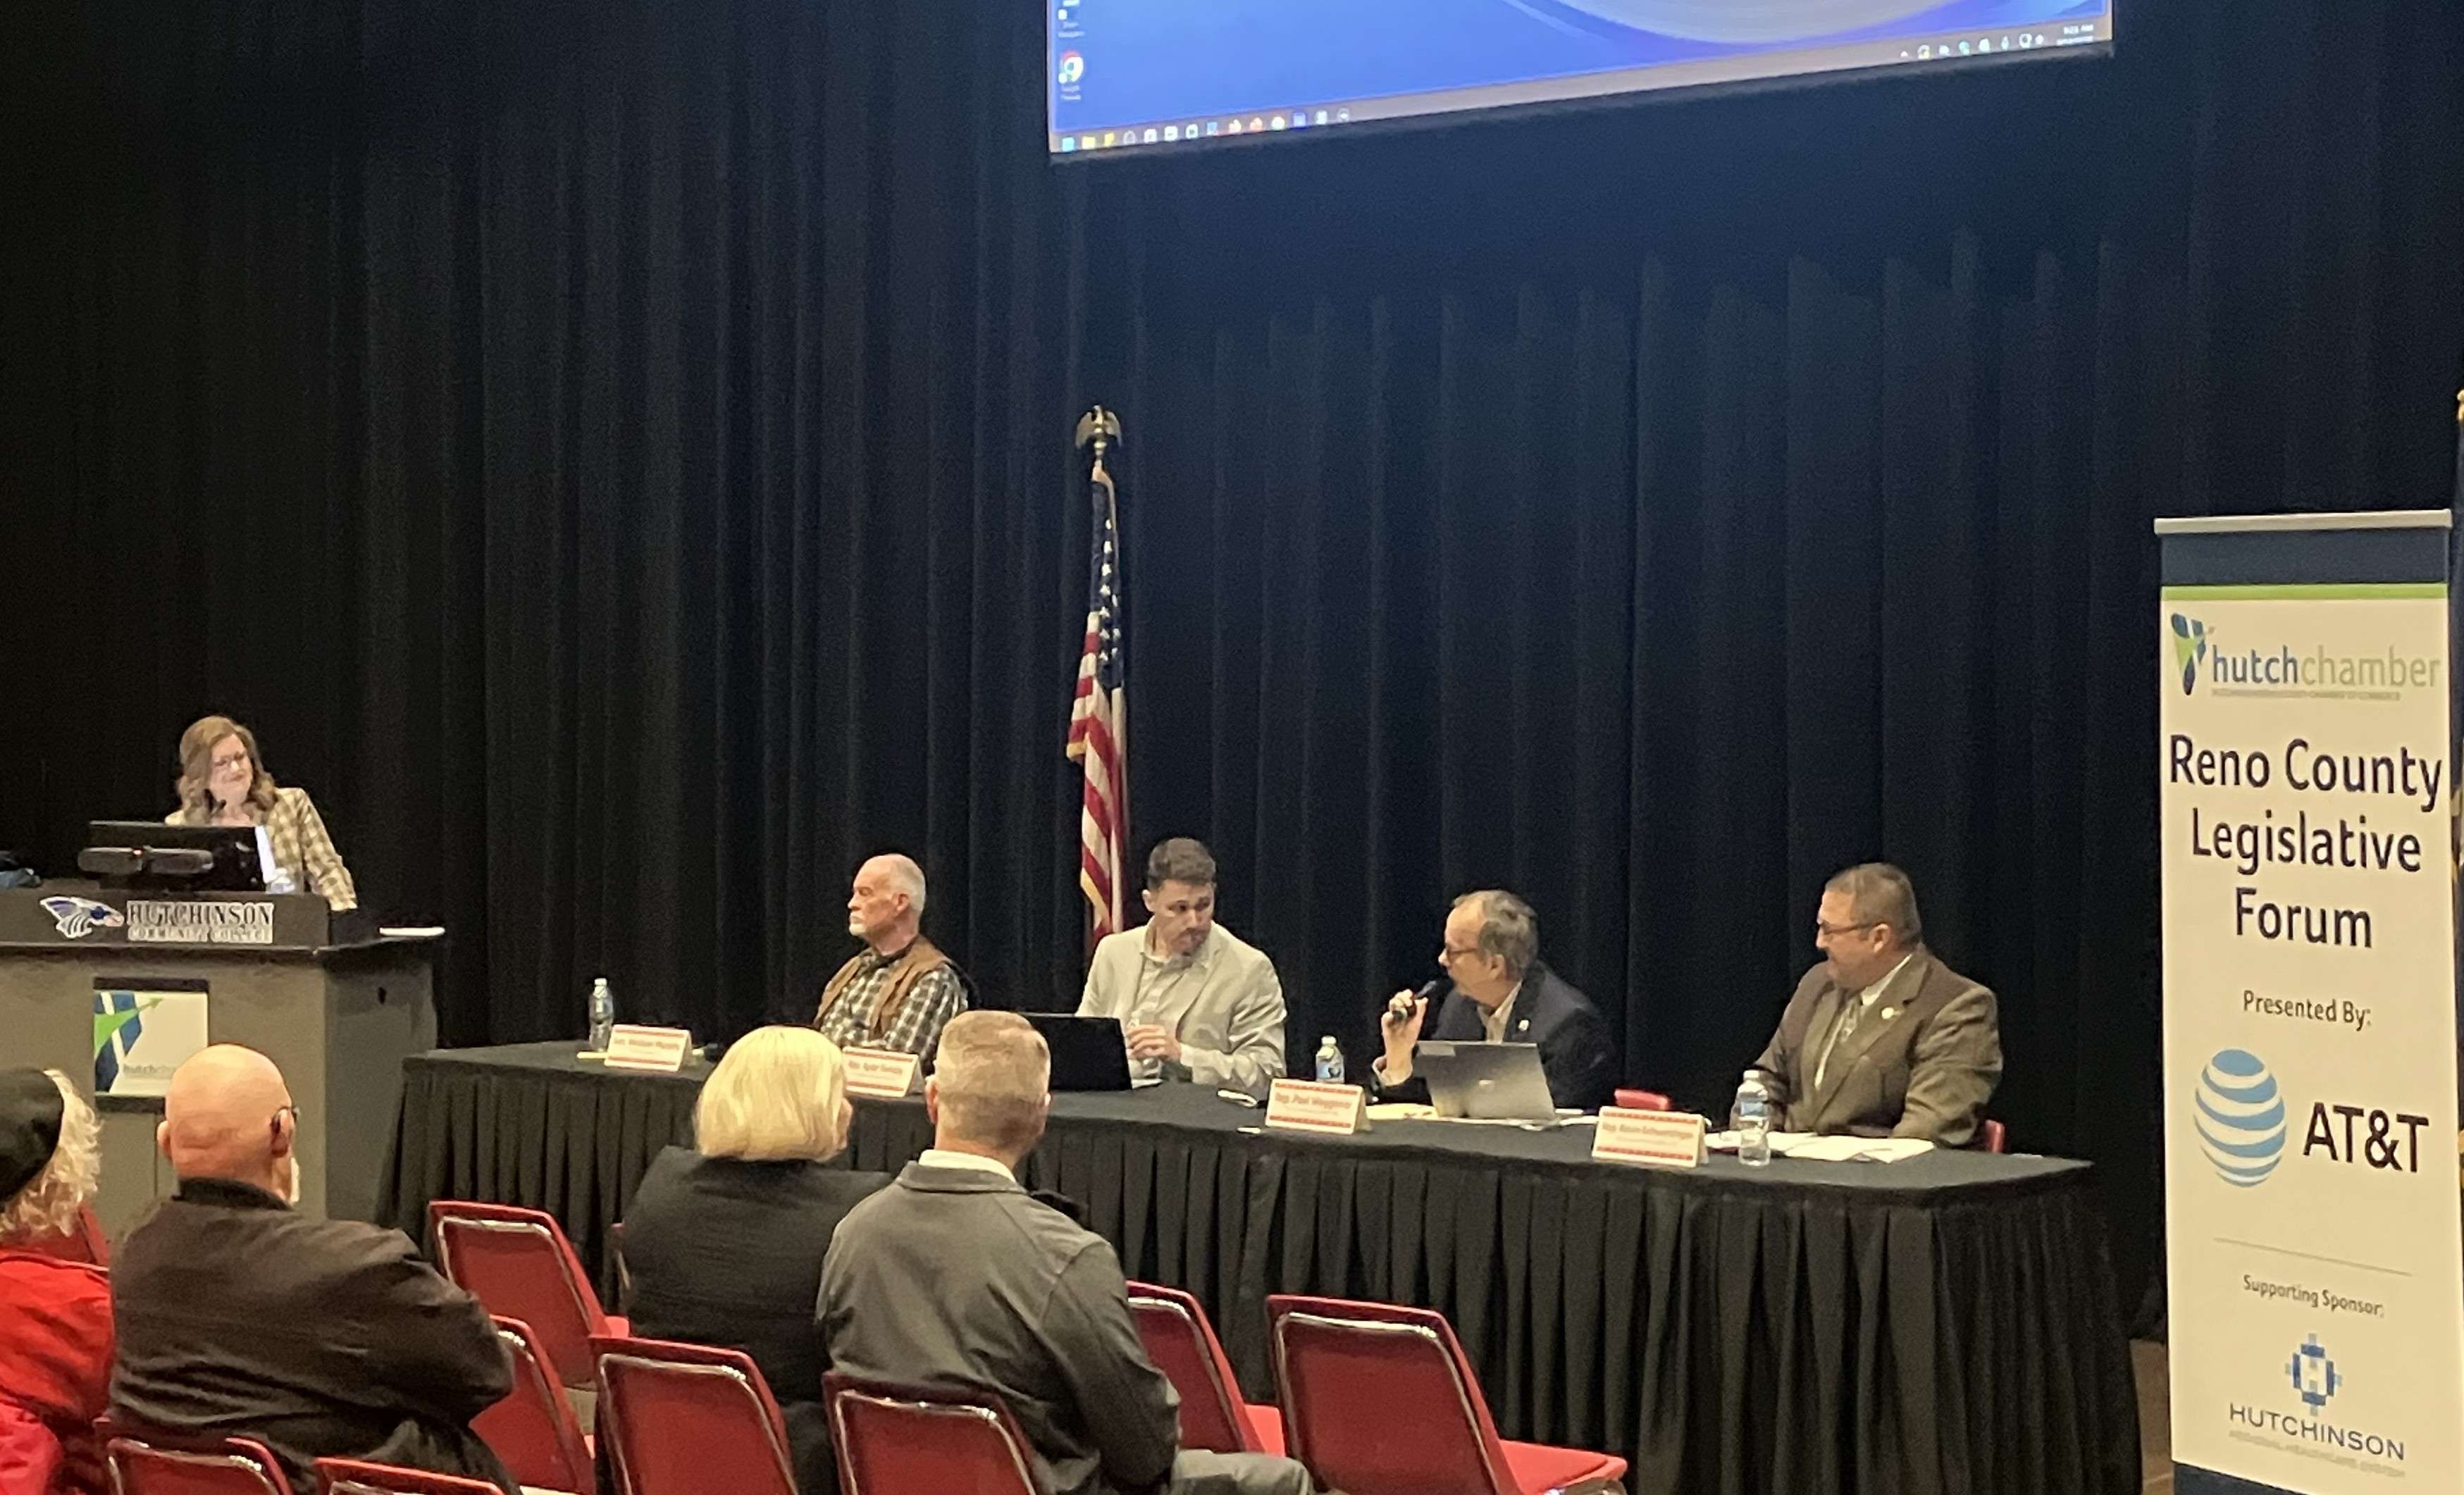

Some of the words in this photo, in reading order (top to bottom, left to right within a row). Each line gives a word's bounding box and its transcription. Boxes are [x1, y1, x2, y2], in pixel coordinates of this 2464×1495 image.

[2170, 734, 2270, 788] Reno
[2284, 738, 2443, 813] County
[2192, 807, 2422, 876] Legislative
[128, 902, 272, 926] HUTCHINSON
[2235, 887, 2372, 948] Forum
[2243, 990, 2337, 1023] Presented
[2343, 1001, 2372, 1031] By:
[2303, 1102, 2429, 1173] AT&T
[2243, 1274, 2318, 1308] Supporting
[2229, 1402, 2405, 1460] HUTCHINSON
